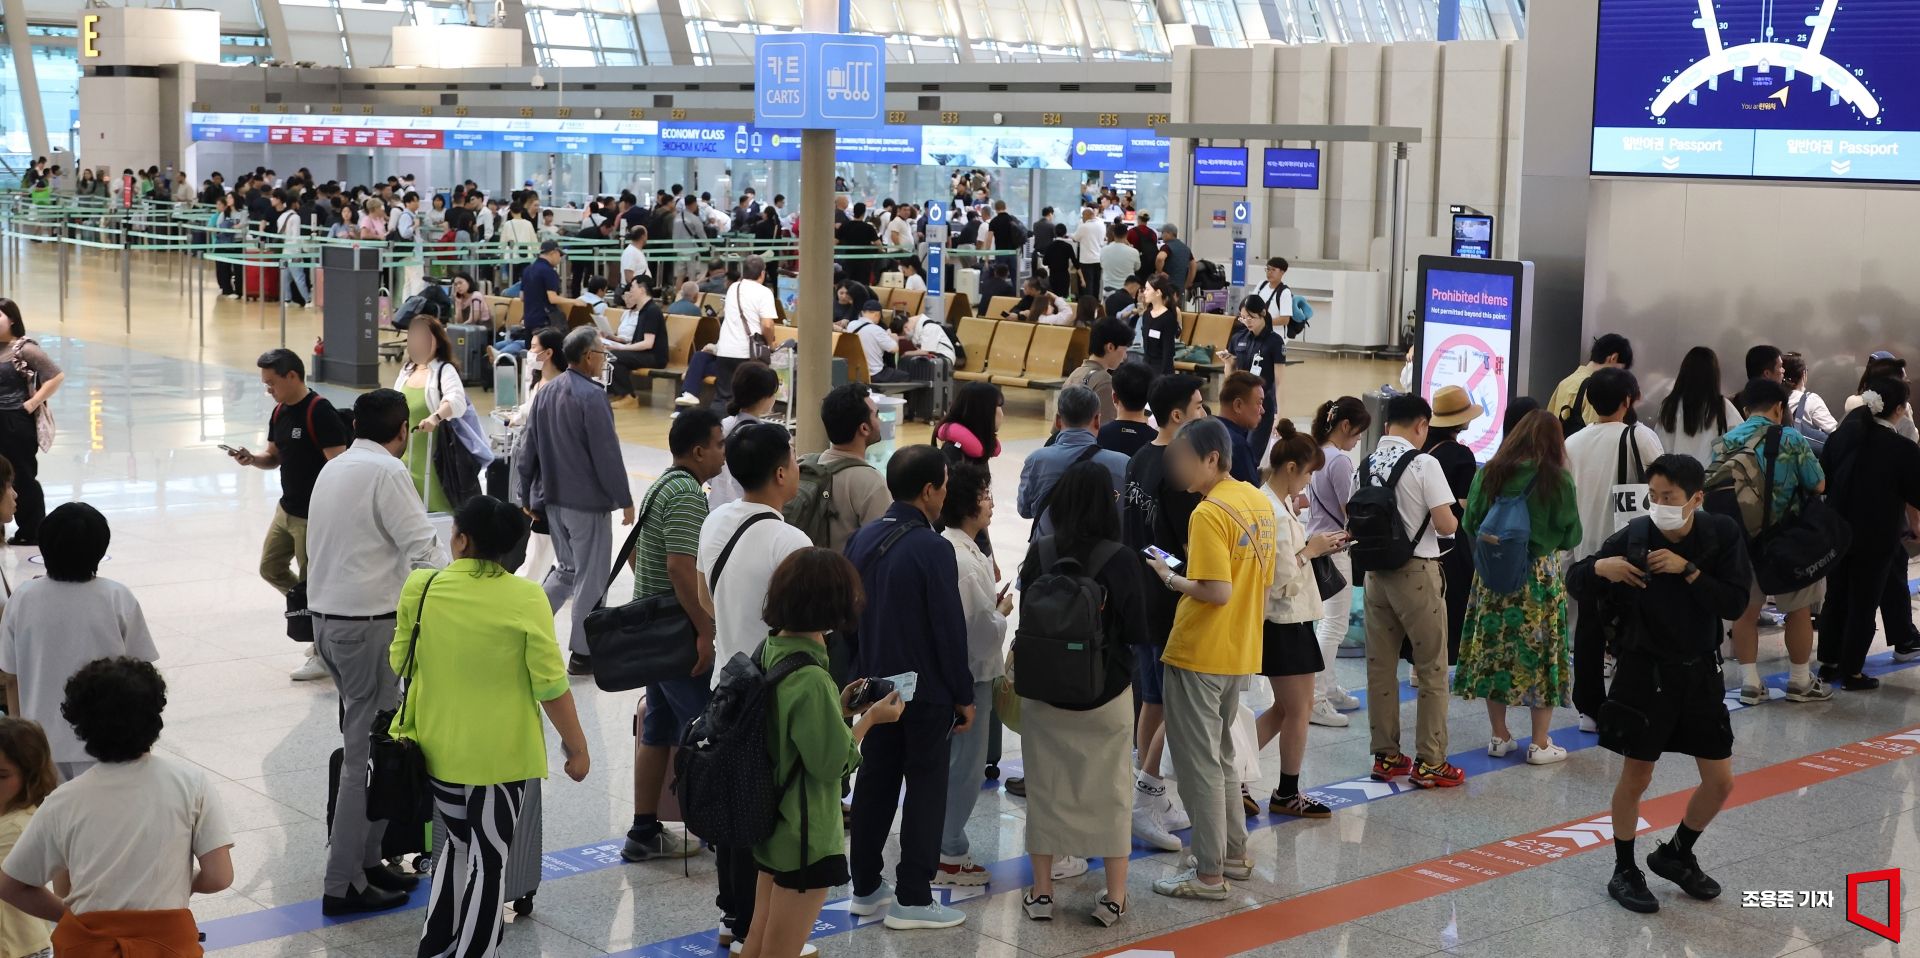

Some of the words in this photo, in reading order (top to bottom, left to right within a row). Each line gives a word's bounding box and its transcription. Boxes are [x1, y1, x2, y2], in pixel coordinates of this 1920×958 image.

[1718, 22, 1729, 30] 30
[84, 15, 100, 57] E
[1797, 34, 1807, 42] 25
[767, 56, 800, 84] 카트
[1854, 68, 1864, 76] 10
[1662, 75, 1671, 83] 45
[767, 89, 800, 104] CARTS
[1852, 105, 1856, 113] 1
[889, 111, 906, 123] E32
[941, 112, 959, 124] E33
[1043, 113, 1062, 125] E34
[1099, 113, 1118, 126] E35
[1147, 114, 1167, 127] E36
[1657, 117, 1666, 125] 50
[1876, 117, 1882, 125] 5
[662, 128, 699, 139] ECONOMY
[701, 129, 725, 140] CLASS
[662, 141, 693, 152] ЭКОНОМ
[694, 142, 717, 153] КЛАСС
[1622, 136, 1664, 151] 일반여권
[1669, 138, 1723, 153] Passport
[1787, 139, 1833, 155] 일반여권
[1838, 140, 1899, 156] Passport
[1431, 288, 1480, 304] Prohibited
[1481, 293, 1508, 306] Items
[1440, 308, 1464, 317] permitted
[1464, 310, 1482, 319] beyond
[1482, 311, 1492, 319] this
[1793, 548, 1837, 577] Supreme
[1506, 858, 1536, 868] ONLY
